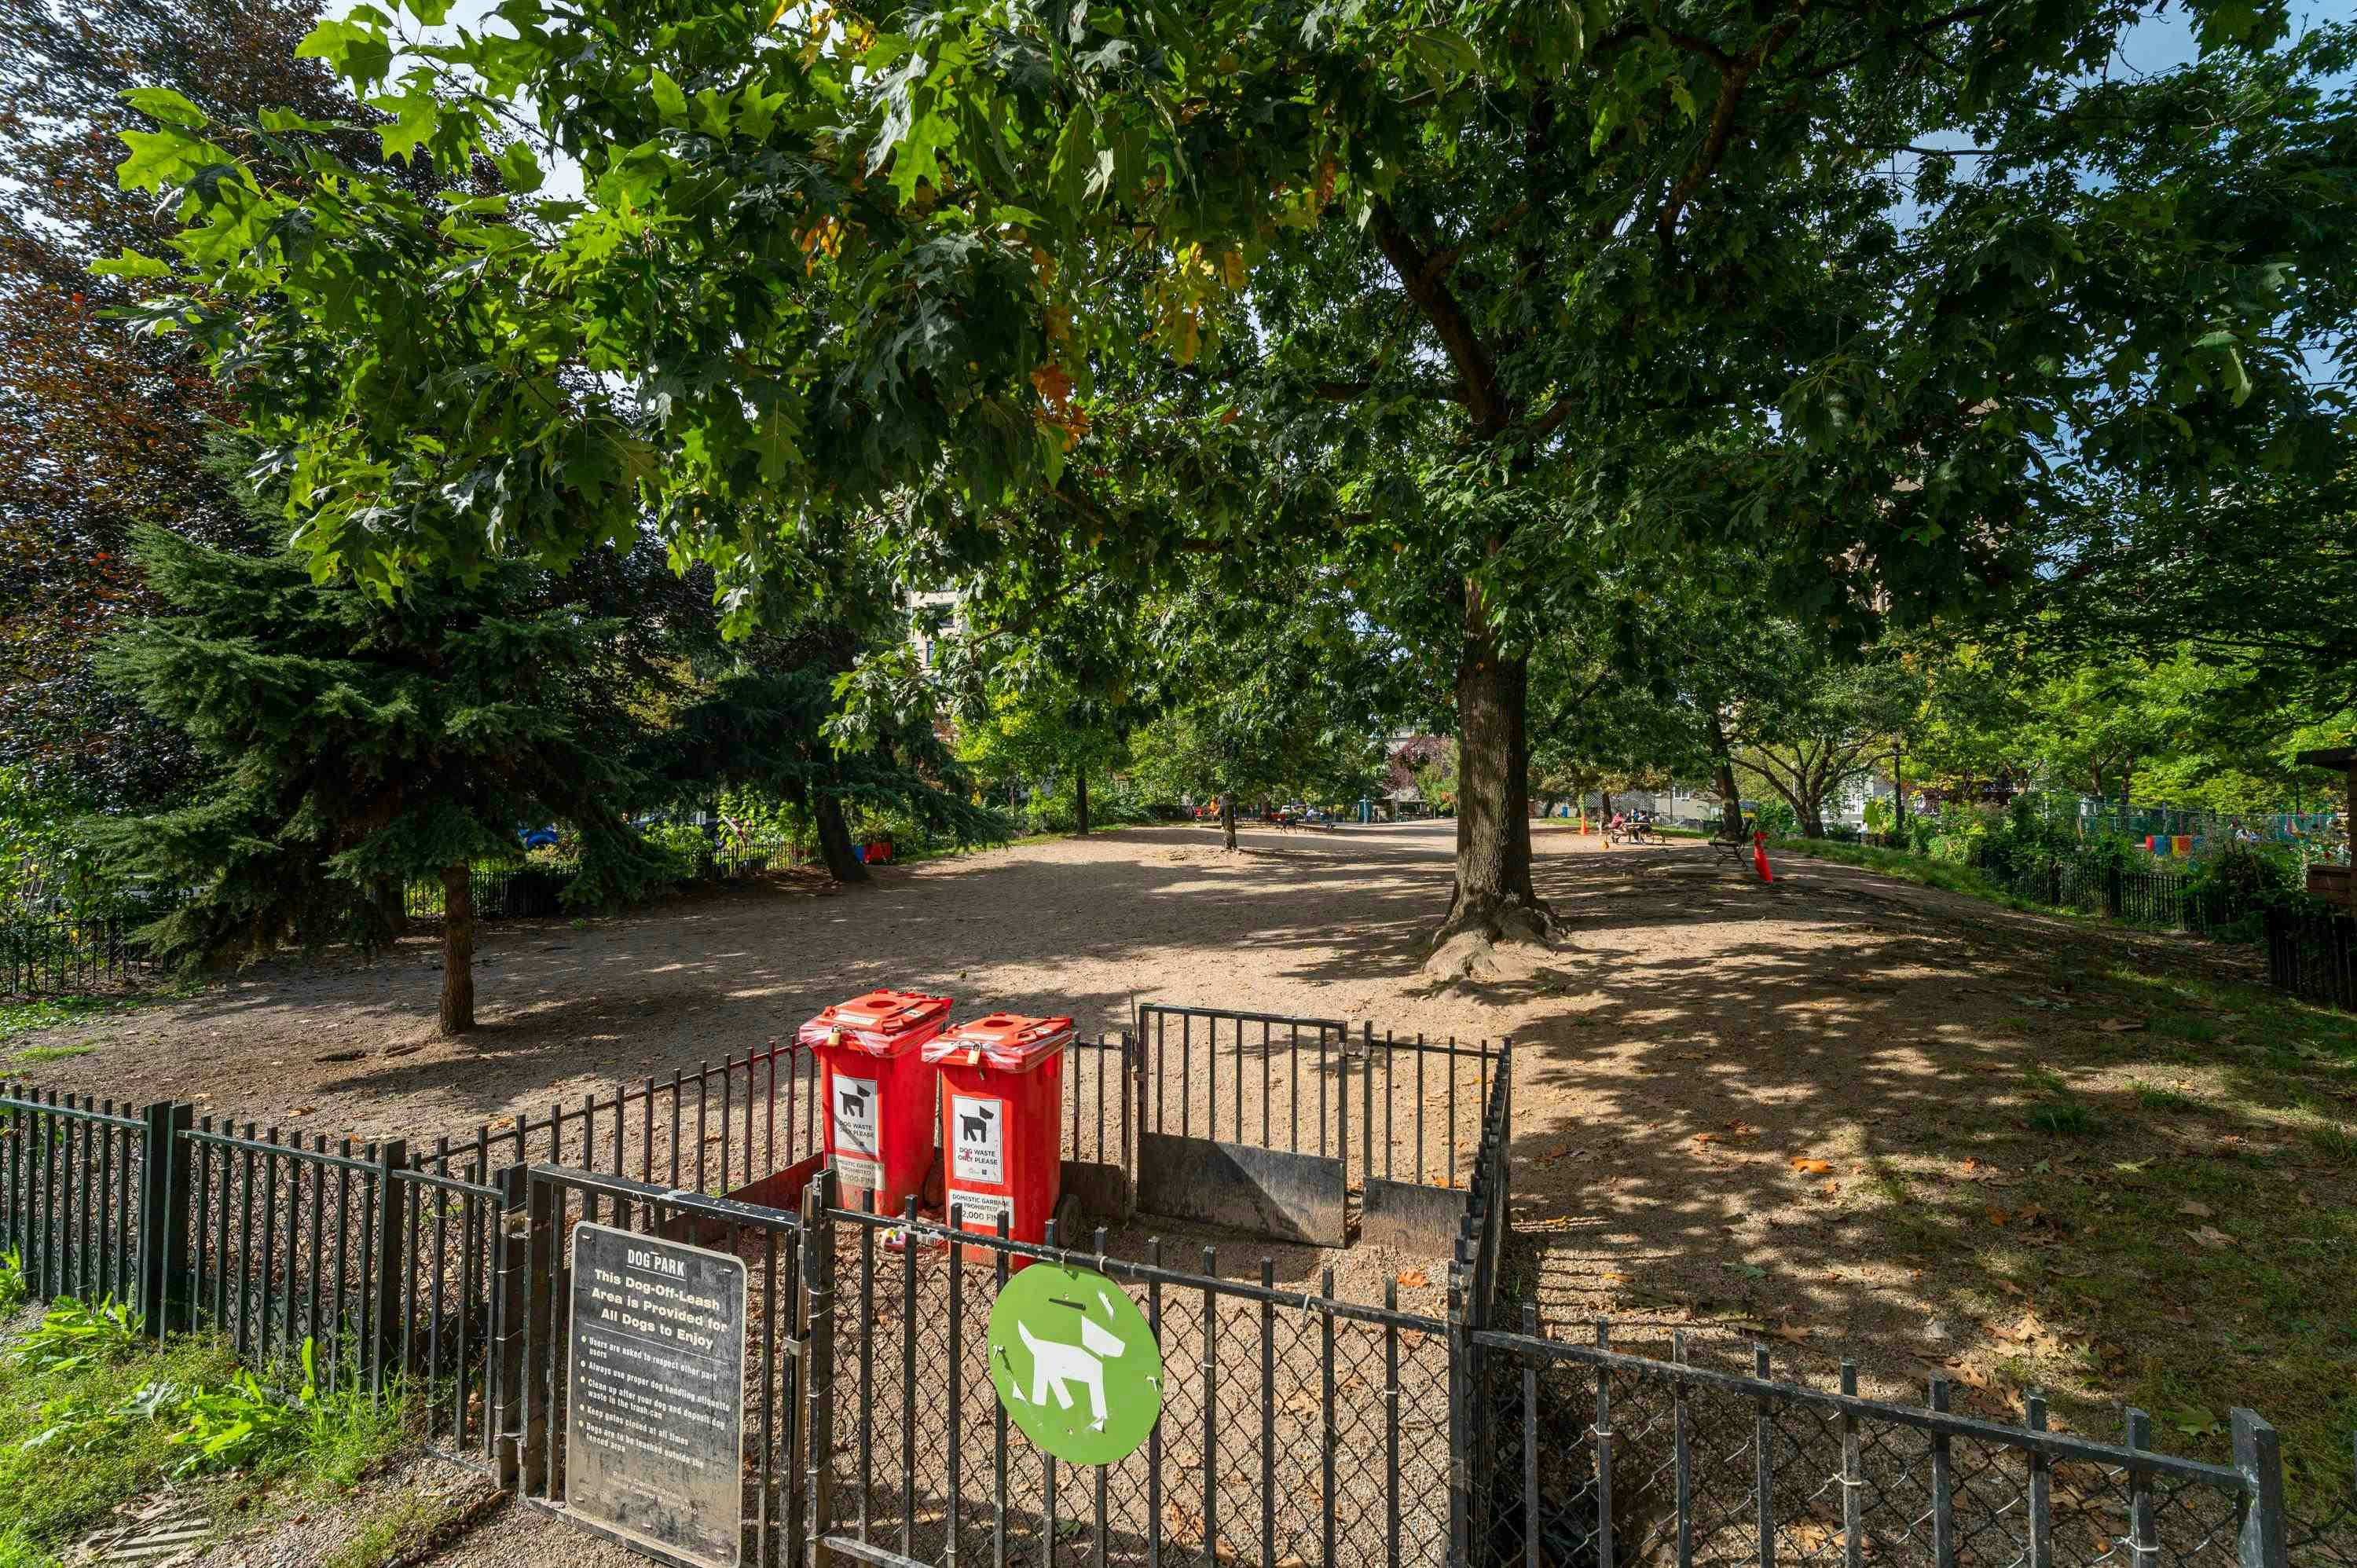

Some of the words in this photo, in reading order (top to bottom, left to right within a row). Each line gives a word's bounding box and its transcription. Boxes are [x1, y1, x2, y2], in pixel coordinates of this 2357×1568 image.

[830, 1157, 856, 1167] DOSTIC
[952, 1194, 981, 1203] DOMESTIC
[963, 1203, 998, 1211] PROHIBITED
[628, 1249, 651, 1268] DOG
[654, 1254, 685, 1277] PARK
[592, 1287, 623, 1305] Area
[627, 1295, 639, 1309] is
[643, 1300, 704, 1326] Provided
[708, 1317, 728, 1332] for
[595, 1269, 621, 1284] This
[625, 1276, 720, 1310] Dog-Off-Leash
[601, 1308, 618, 1322] All
[622, 1313, 655, 1332] Dogs
[660, 1324, 673, 1336] to
[676, 1328, 713, 1350] Enjoy
[589, 1347, 607, 1359] users
[589, 1337, 607, 1349] Users
[609, 1343, 621, 1353] are
[622, 1347, 642, 1359] asked
[644, 1352, 651, 1361] to
[653, 1357, 679, 1370] respect
[680, 1365, 698, 1376] other
[701, 1371, 717, 1382] park
[588, 1361, 611, 1376] Always
[614, 1370, 625, 1379] use
[627, 1374, 649, 1386] proper
[651, 1379, 663, 1392] dog
[665, 1383, 695, 1402] handling
[587, 1405, 603, 1420] Keep
[605, 1413, 623, 1424] gates
[625, 1420, 647, 1432] closed
[658, 1429, 667, 1439] all
[669, 1432, 688, 1445] times
[588, 1379, 607, 1391] Clean
[609, 1387, 618, 1395] up
[618, 1388, 636, 1400] after
[637, 1395, 652, 1406] your
[654, 1398, 666, 1412] dog
[668, 1405, 682, 1415] and
[684, 1408, 709, 1424] deposit
[712, 1417, 725, 1431] dog
[588, 1390, 607, 1401] waste
[609, 1395, 616, 1405] in
[618, 1398, 629, 1409] the
[630, 1402, 648, 1415] trash
[650, 1409, 662, 1420] can
[586, 1432, 608, 1447] fenced
[610, 1442, 625, 1453] area
[586, 1422, 602, 1434] Dogs
[603, 1430, 614, 1438] are
[617, 1432, 624, 1441] to
[625, 1434, 634, 1445] be
[636, 1438, 662, 1454] leashed
[665, 1449, 691, 1464] outside
[692, 1458, 704, 1469] the
